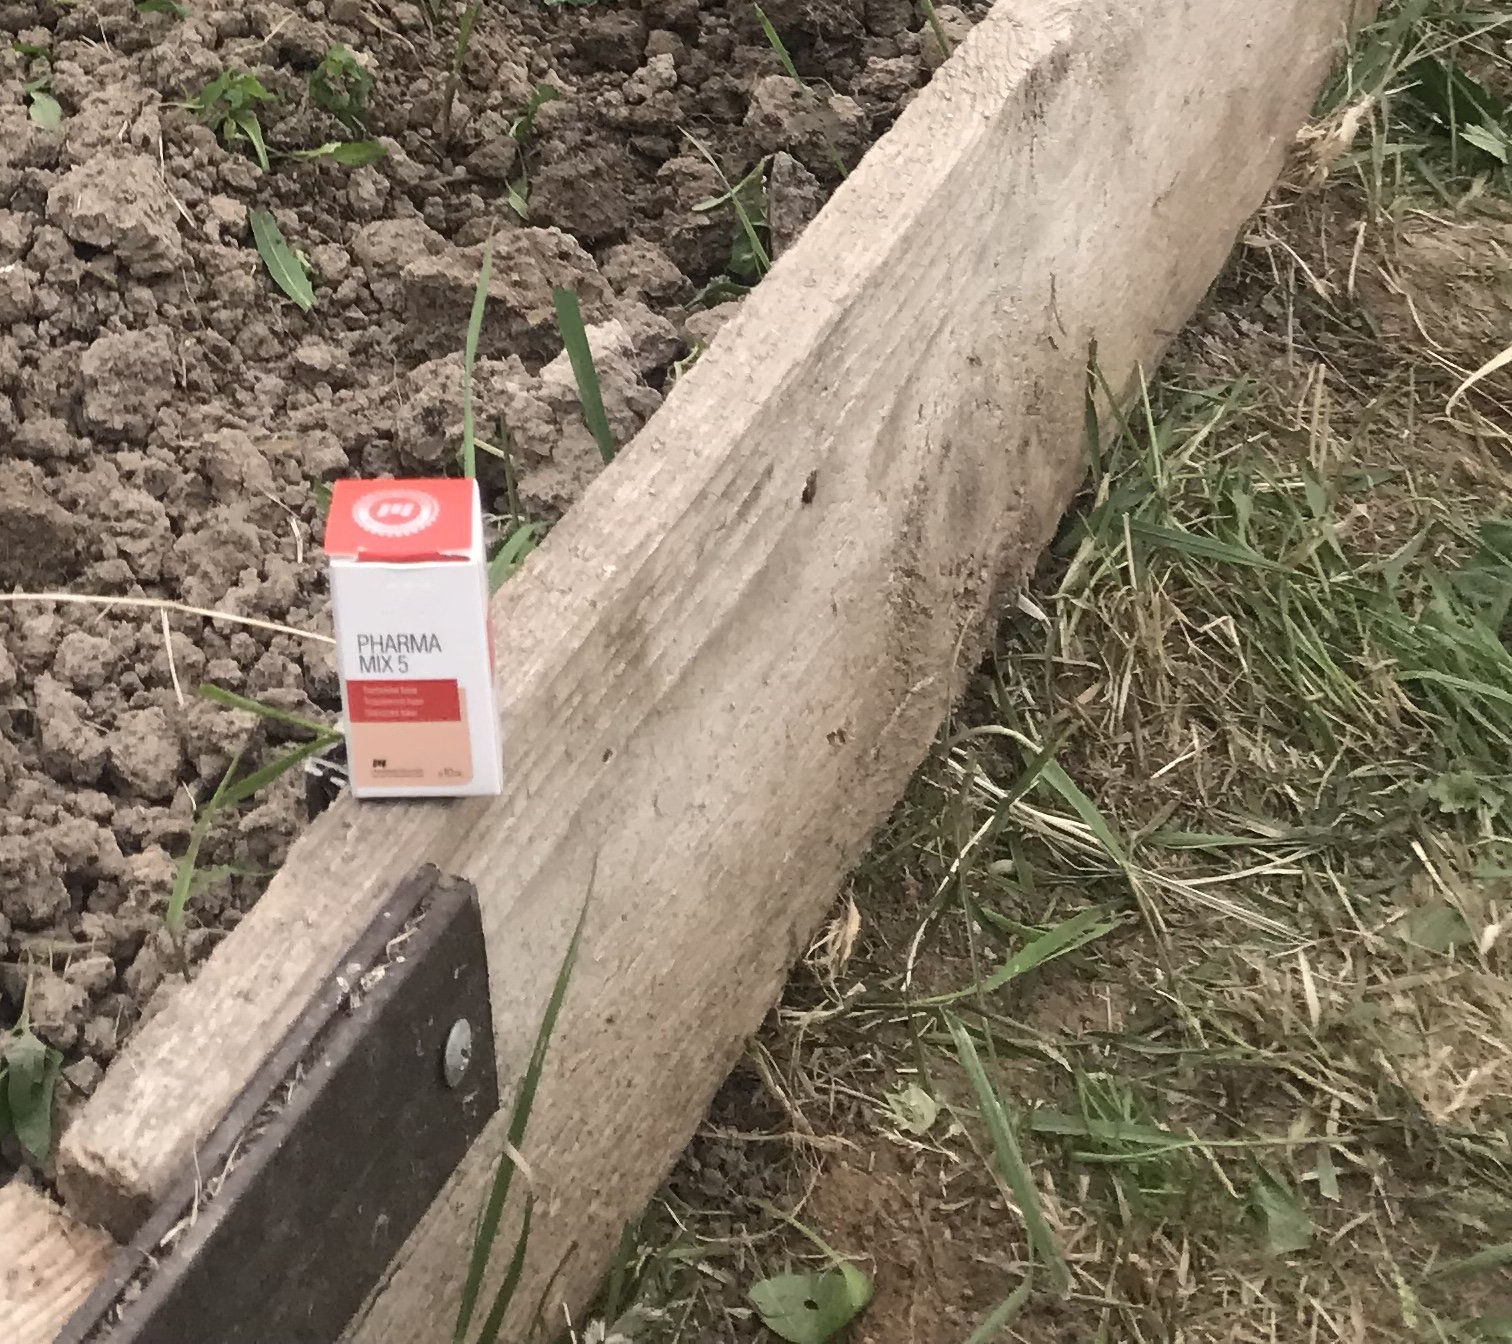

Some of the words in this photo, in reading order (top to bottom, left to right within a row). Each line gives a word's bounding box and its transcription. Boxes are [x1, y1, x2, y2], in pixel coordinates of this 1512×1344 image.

[356, 633, 442, 653] PHARMA
[359, 655, 393, 673] MIX
[398, 655, 409, 673] 5
